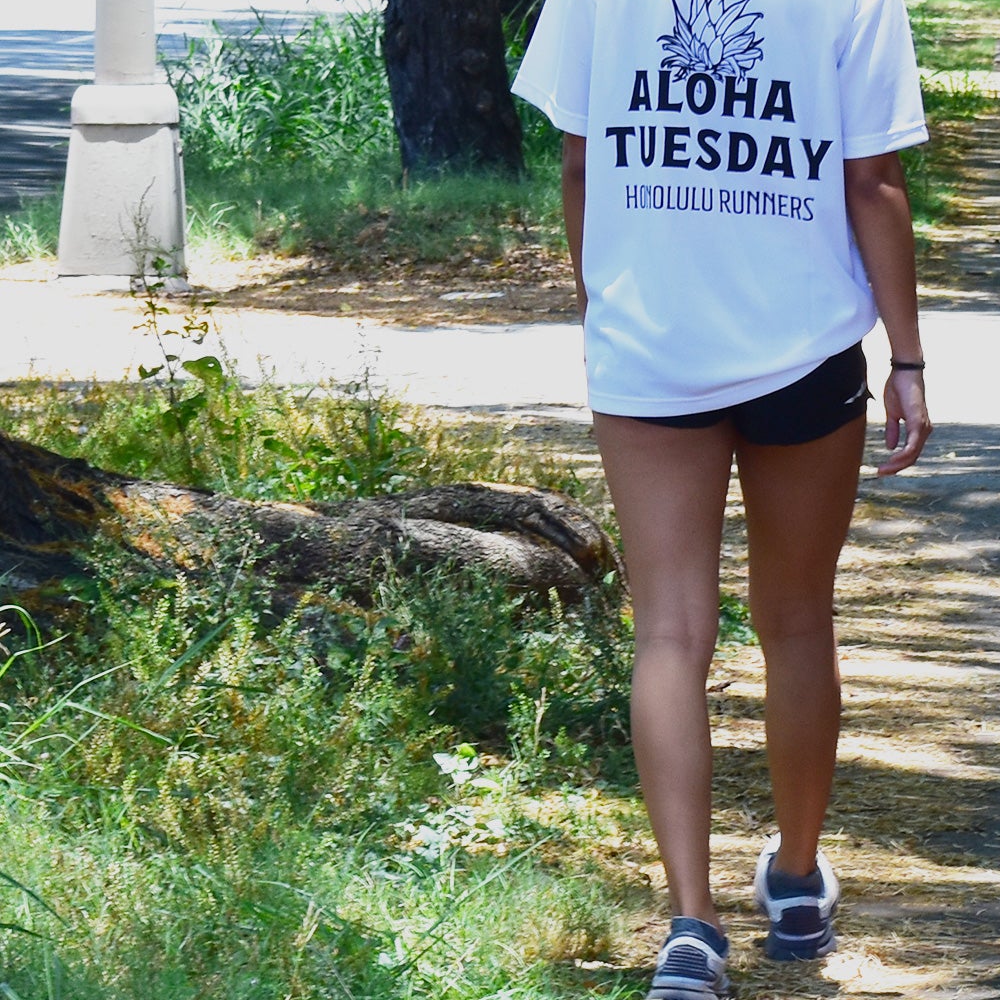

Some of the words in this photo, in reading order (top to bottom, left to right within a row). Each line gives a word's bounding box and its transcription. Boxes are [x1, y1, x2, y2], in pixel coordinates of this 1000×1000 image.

[628, 69, 796, 123] ALOHA
[605, 125, 834, 181] TUESDAY
[719, 188, 815, 222] RUNNERS
